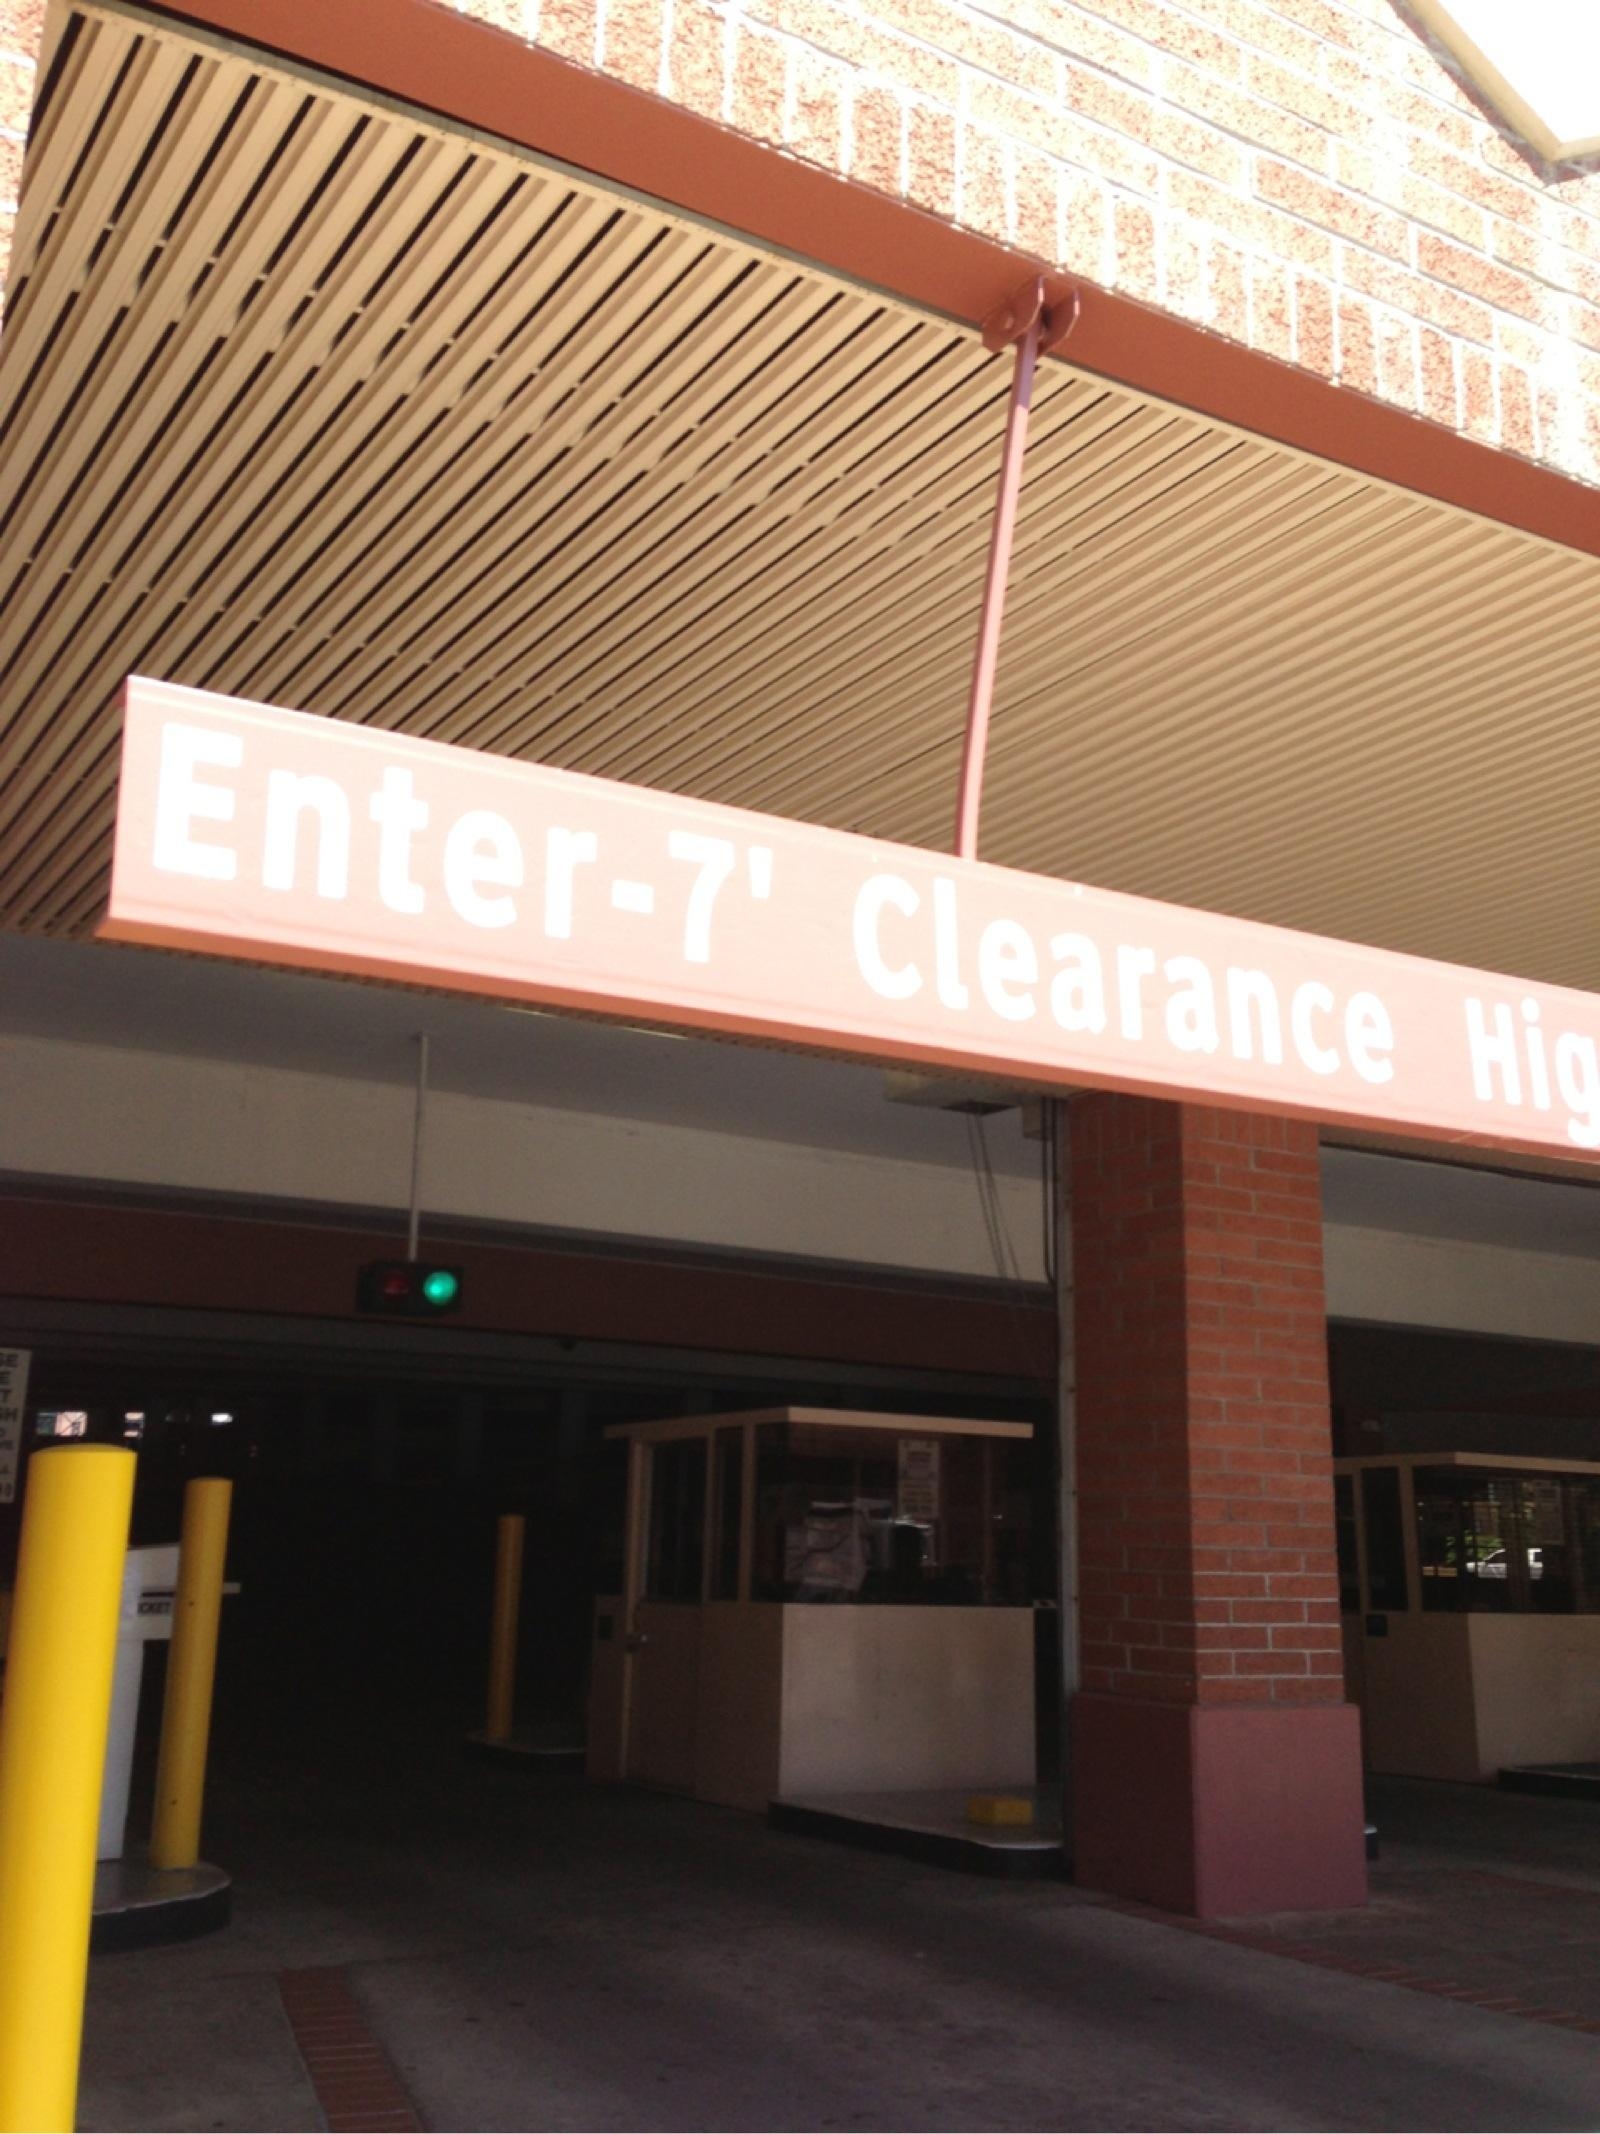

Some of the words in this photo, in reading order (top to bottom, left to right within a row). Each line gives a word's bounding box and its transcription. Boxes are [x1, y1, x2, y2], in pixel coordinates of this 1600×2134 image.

[150, 720, 774, 964] Enter-7'
[851, 872, 1395, 1084] Clearance
[1464, 997, 1600, 1147] Hig
